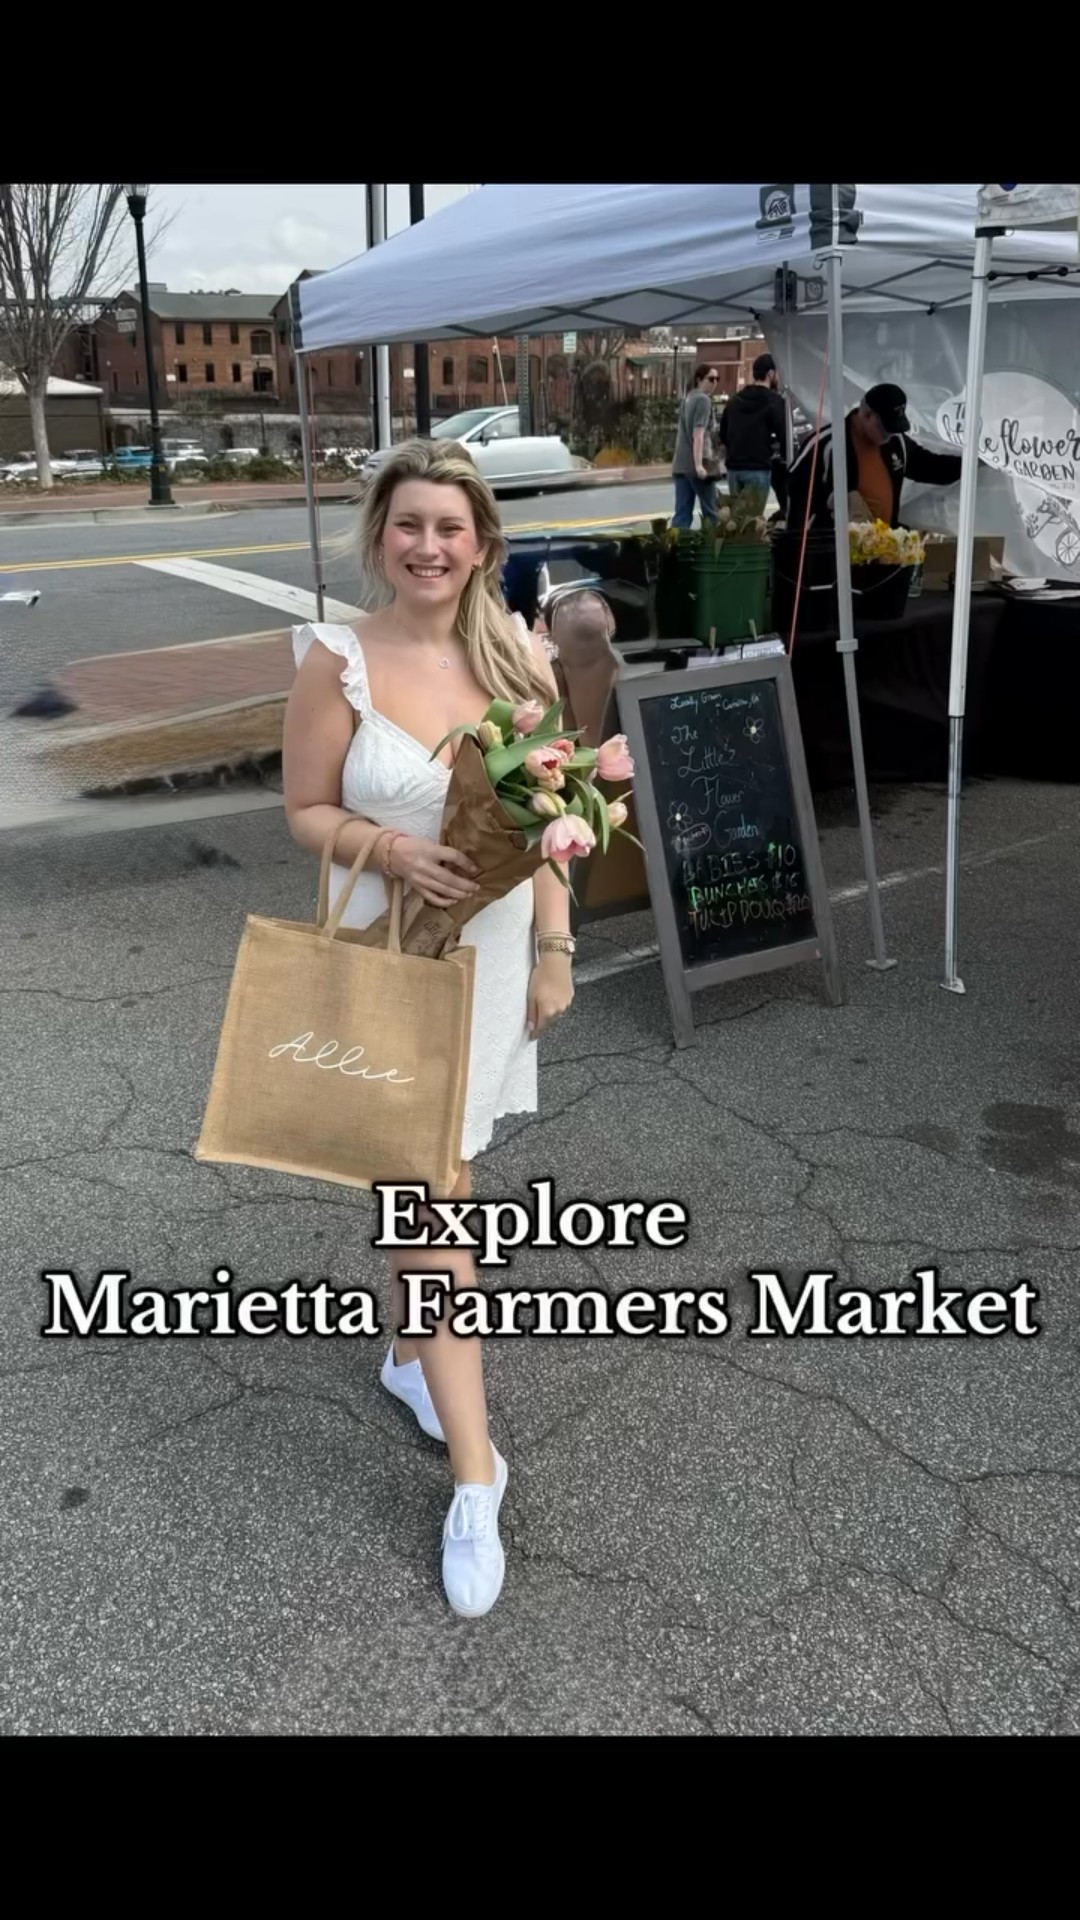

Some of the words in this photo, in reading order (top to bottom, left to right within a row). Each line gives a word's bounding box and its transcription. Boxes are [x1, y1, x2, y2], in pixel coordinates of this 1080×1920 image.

[1000, 418, 1080, 468] flower
[1013, 459, 1075, 481] GARDEN
[671, 725, 699, 744] The
[268, 1031, 416, 1083] Allie
